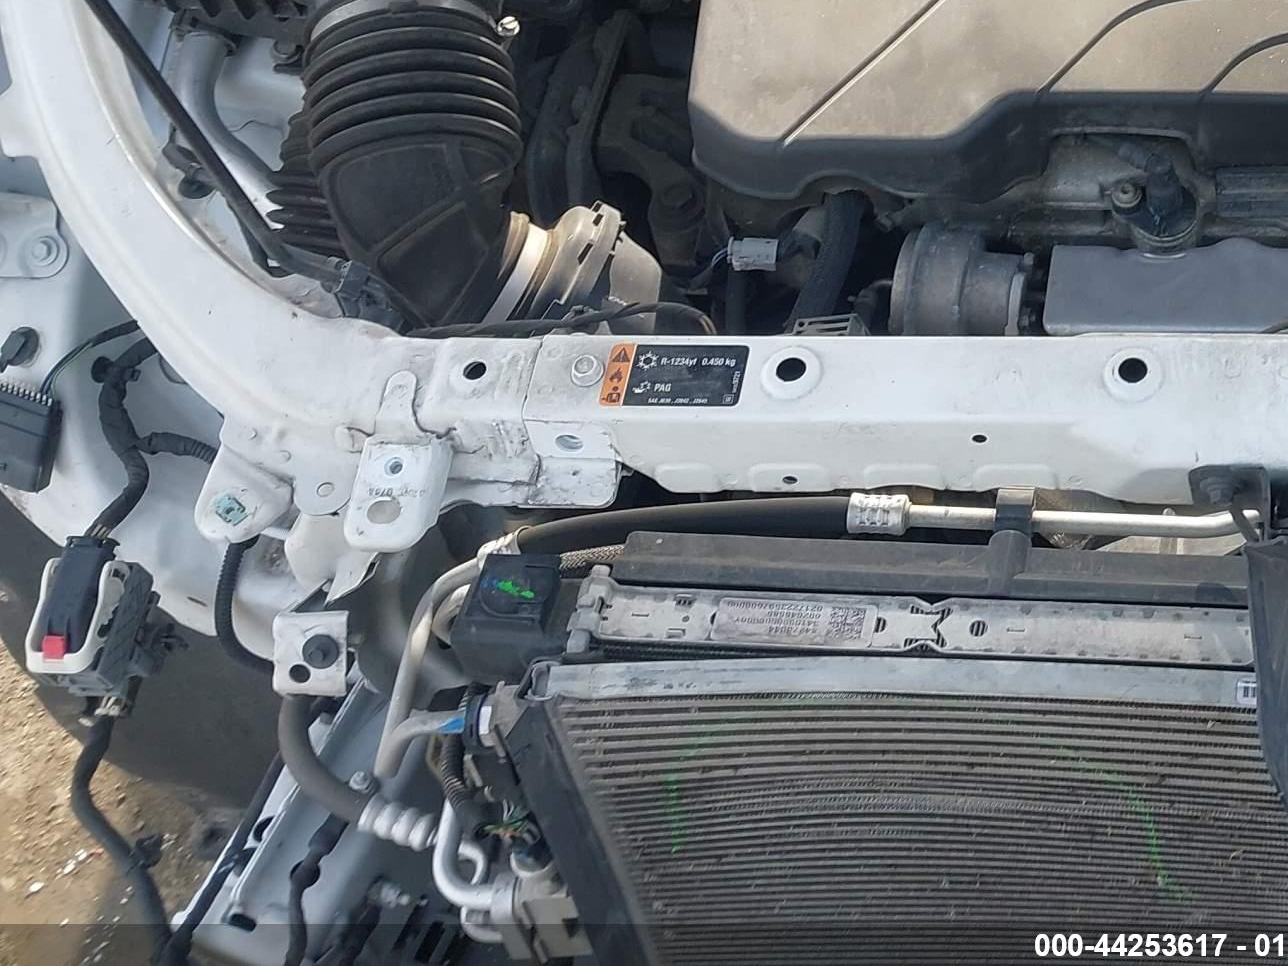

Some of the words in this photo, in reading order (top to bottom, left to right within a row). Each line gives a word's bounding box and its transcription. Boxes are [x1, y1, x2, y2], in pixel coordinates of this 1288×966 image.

[661, 357, 698, 367] R-1234yf
[702, 358, 724, 366] 0.450
[725, 358, 736, 367] kg
[653, 382, 672, 392] PAG
